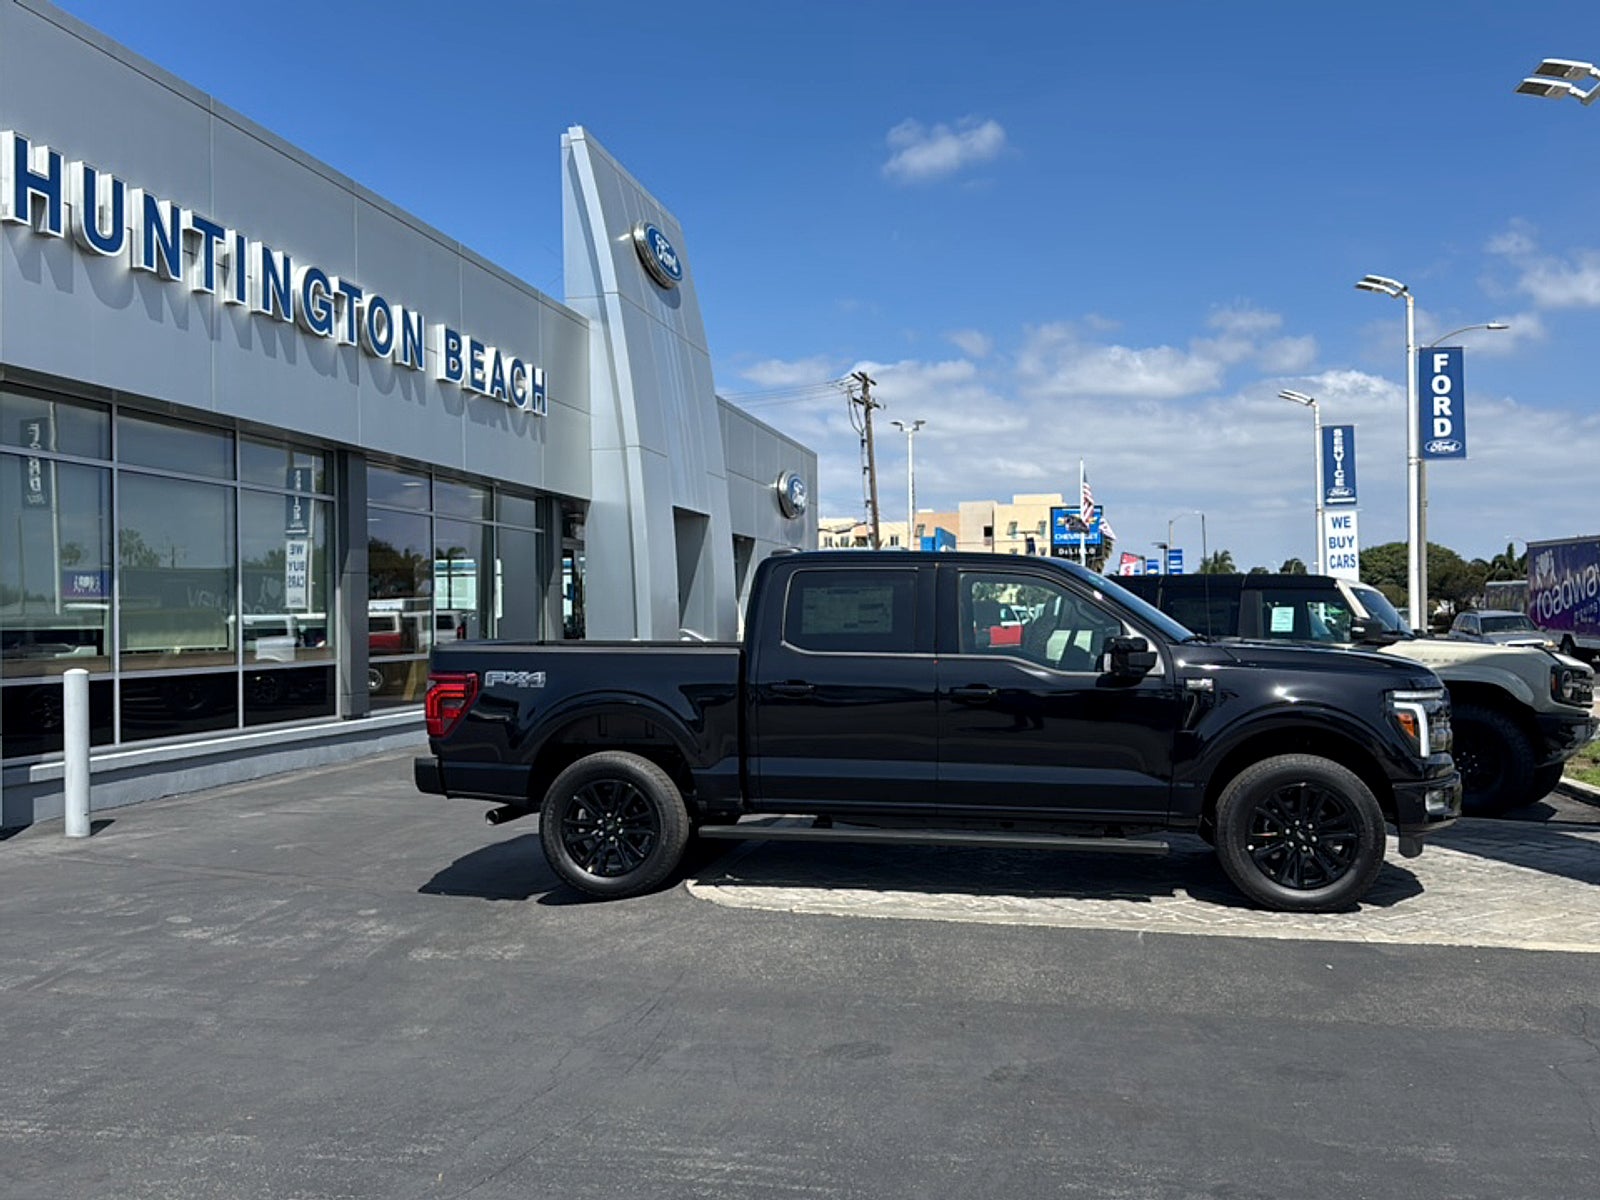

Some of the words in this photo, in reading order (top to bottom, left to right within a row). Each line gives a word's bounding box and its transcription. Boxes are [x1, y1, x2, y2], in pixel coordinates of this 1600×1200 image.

[655, 233, 678, 274] Ford
[1, 130, 425, 371] HUNTINGTON
[437, 324, 548, 416] BEACH
[1431, 353, 1453, 438] FORD
[1430, 440, 1457, 453] Ford
[1333, 428, 1345, 487] SERVICE
[1331, 516, 1351, 529] WE
[1328, 536, 1355, 549] BUY
[1329, 554, 1356, 570] CARS
[485, 670, 546, 687] FX4
